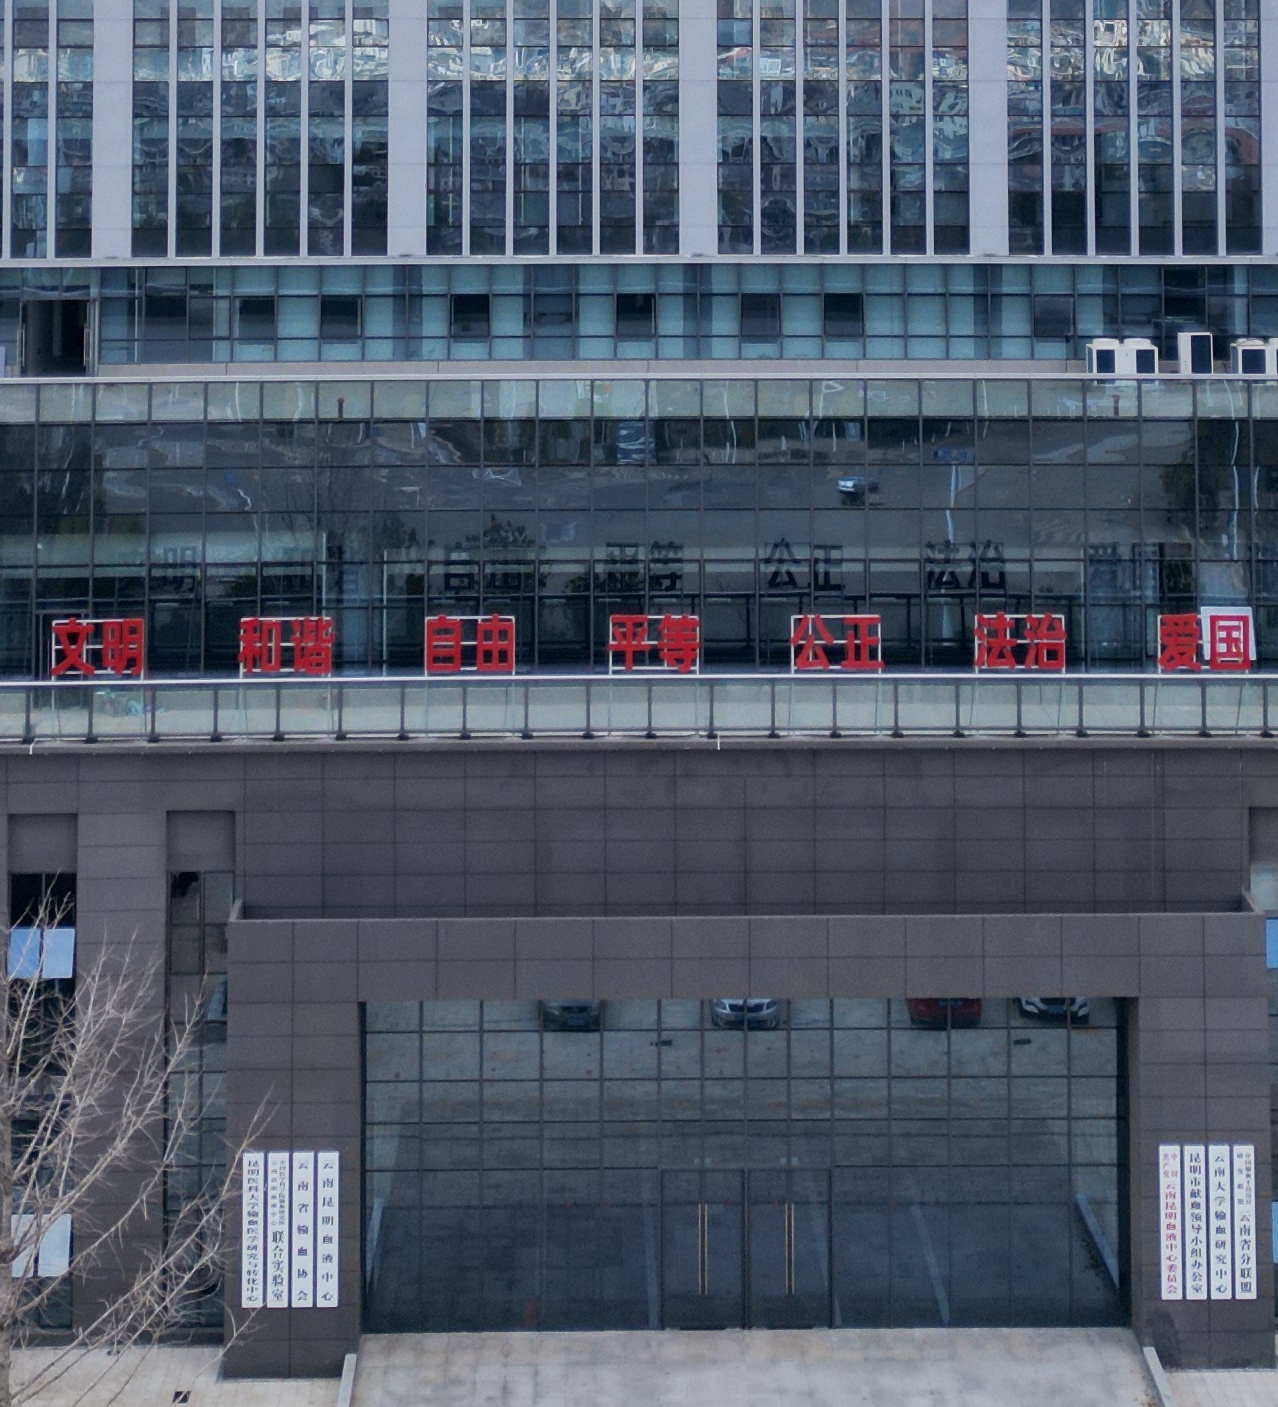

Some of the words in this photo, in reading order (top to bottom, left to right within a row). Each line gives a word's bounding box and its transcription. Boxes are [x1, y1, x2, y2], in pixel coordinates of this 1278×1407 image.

[50, 617, 145, 676] 文明
[237, 617, 335, 674] 和谐
[425, 614, 515, 673] 自由
[607, 614, 701, 673] 平等
[790, 614, 885, 670] 公正
[974, 612, 1067, 670] 法治
[1156, 612, 1252, 672] 爱国
[322, 1161, 335, 1301] 云南昆明血液中心
